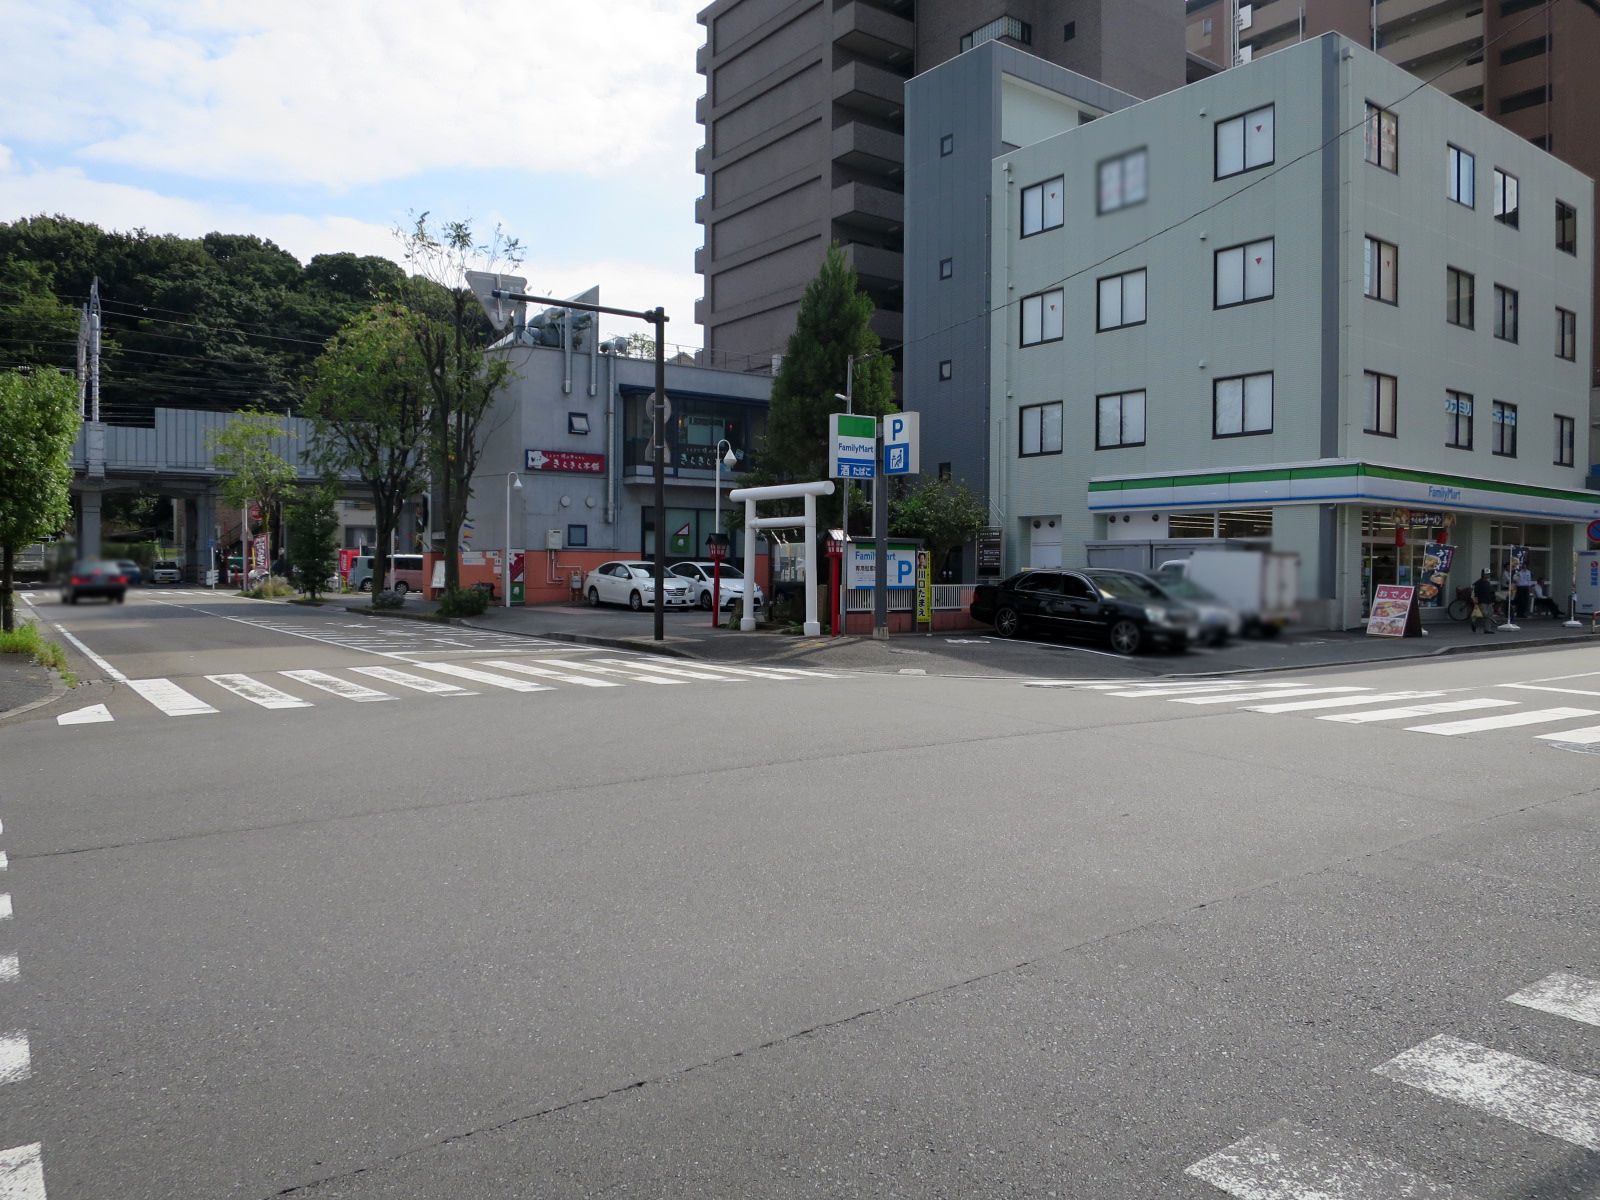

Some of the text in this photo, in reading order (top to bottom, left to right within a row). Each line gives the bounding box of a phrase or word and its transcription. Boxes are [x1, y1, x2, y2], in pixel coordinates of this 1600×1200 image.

[892, 419, 904, 441] P
[838, 442, 874, 453] FamilyMart
[840, 464, 872, 477] 酒 たばこ
[1429, 485, 1461, 502] FamilyMart
[897, 560, 913, 584] P
[918, 570, 926, 617] 川口たまえ
[1377, 590, 1410, 600] おでん
